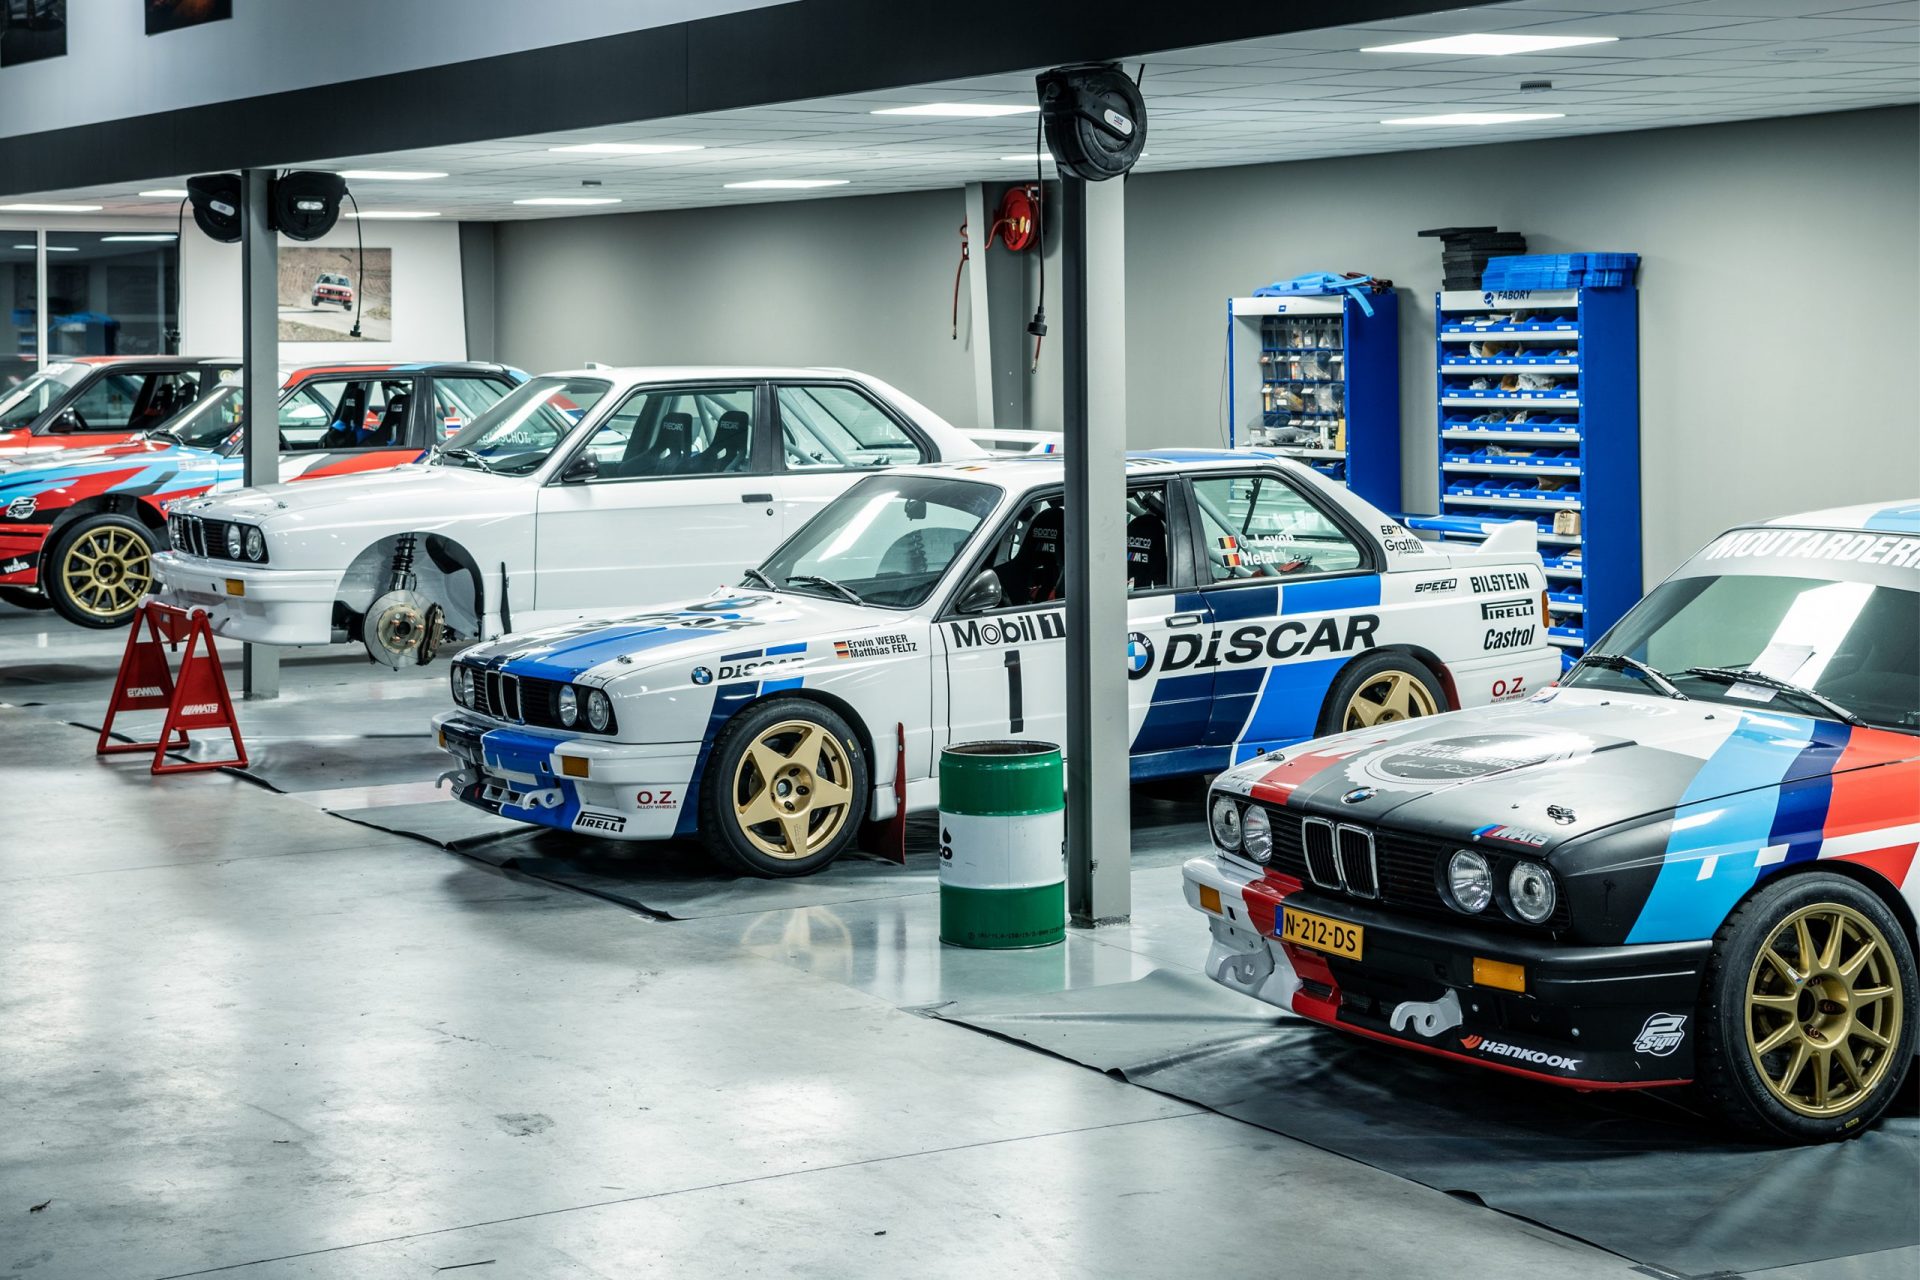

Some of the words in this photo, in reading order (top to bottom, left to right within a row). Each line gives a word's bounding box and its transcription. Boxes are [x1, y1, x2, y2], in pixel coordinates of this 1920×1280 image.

[1497, 290, 1531, 300] FABORY
[1414, 578, 1458, 593] SPEED
[1470, 572, 1530, 593] BILSTEIN
[1481, 598, 1535, 620] PIRELLI
[847, 638, 875, 650] Erwin
[875, 633, 909, 646] WEBER
[950, 616, 1037, 648] Mobil
[1483, 624, 1536, 651] Castrol
[849, 646, 891, 659] Matthias
[891, 642, 918, 654] FELTZ
[1004, 649, 1024, 734] 1
[1492, 677, 1527, 697] O.Z.
[190, 703, 219, 715] MATS
[636, 790, 677, 805] O.Z.
[575, 811, 627, 833] PIRELLI
[1284, 912, 1357, 953] N-212-DS
[1640, 1017, 1680, 1039] 2
[1637, 1034, 1680, 1051] Sign
